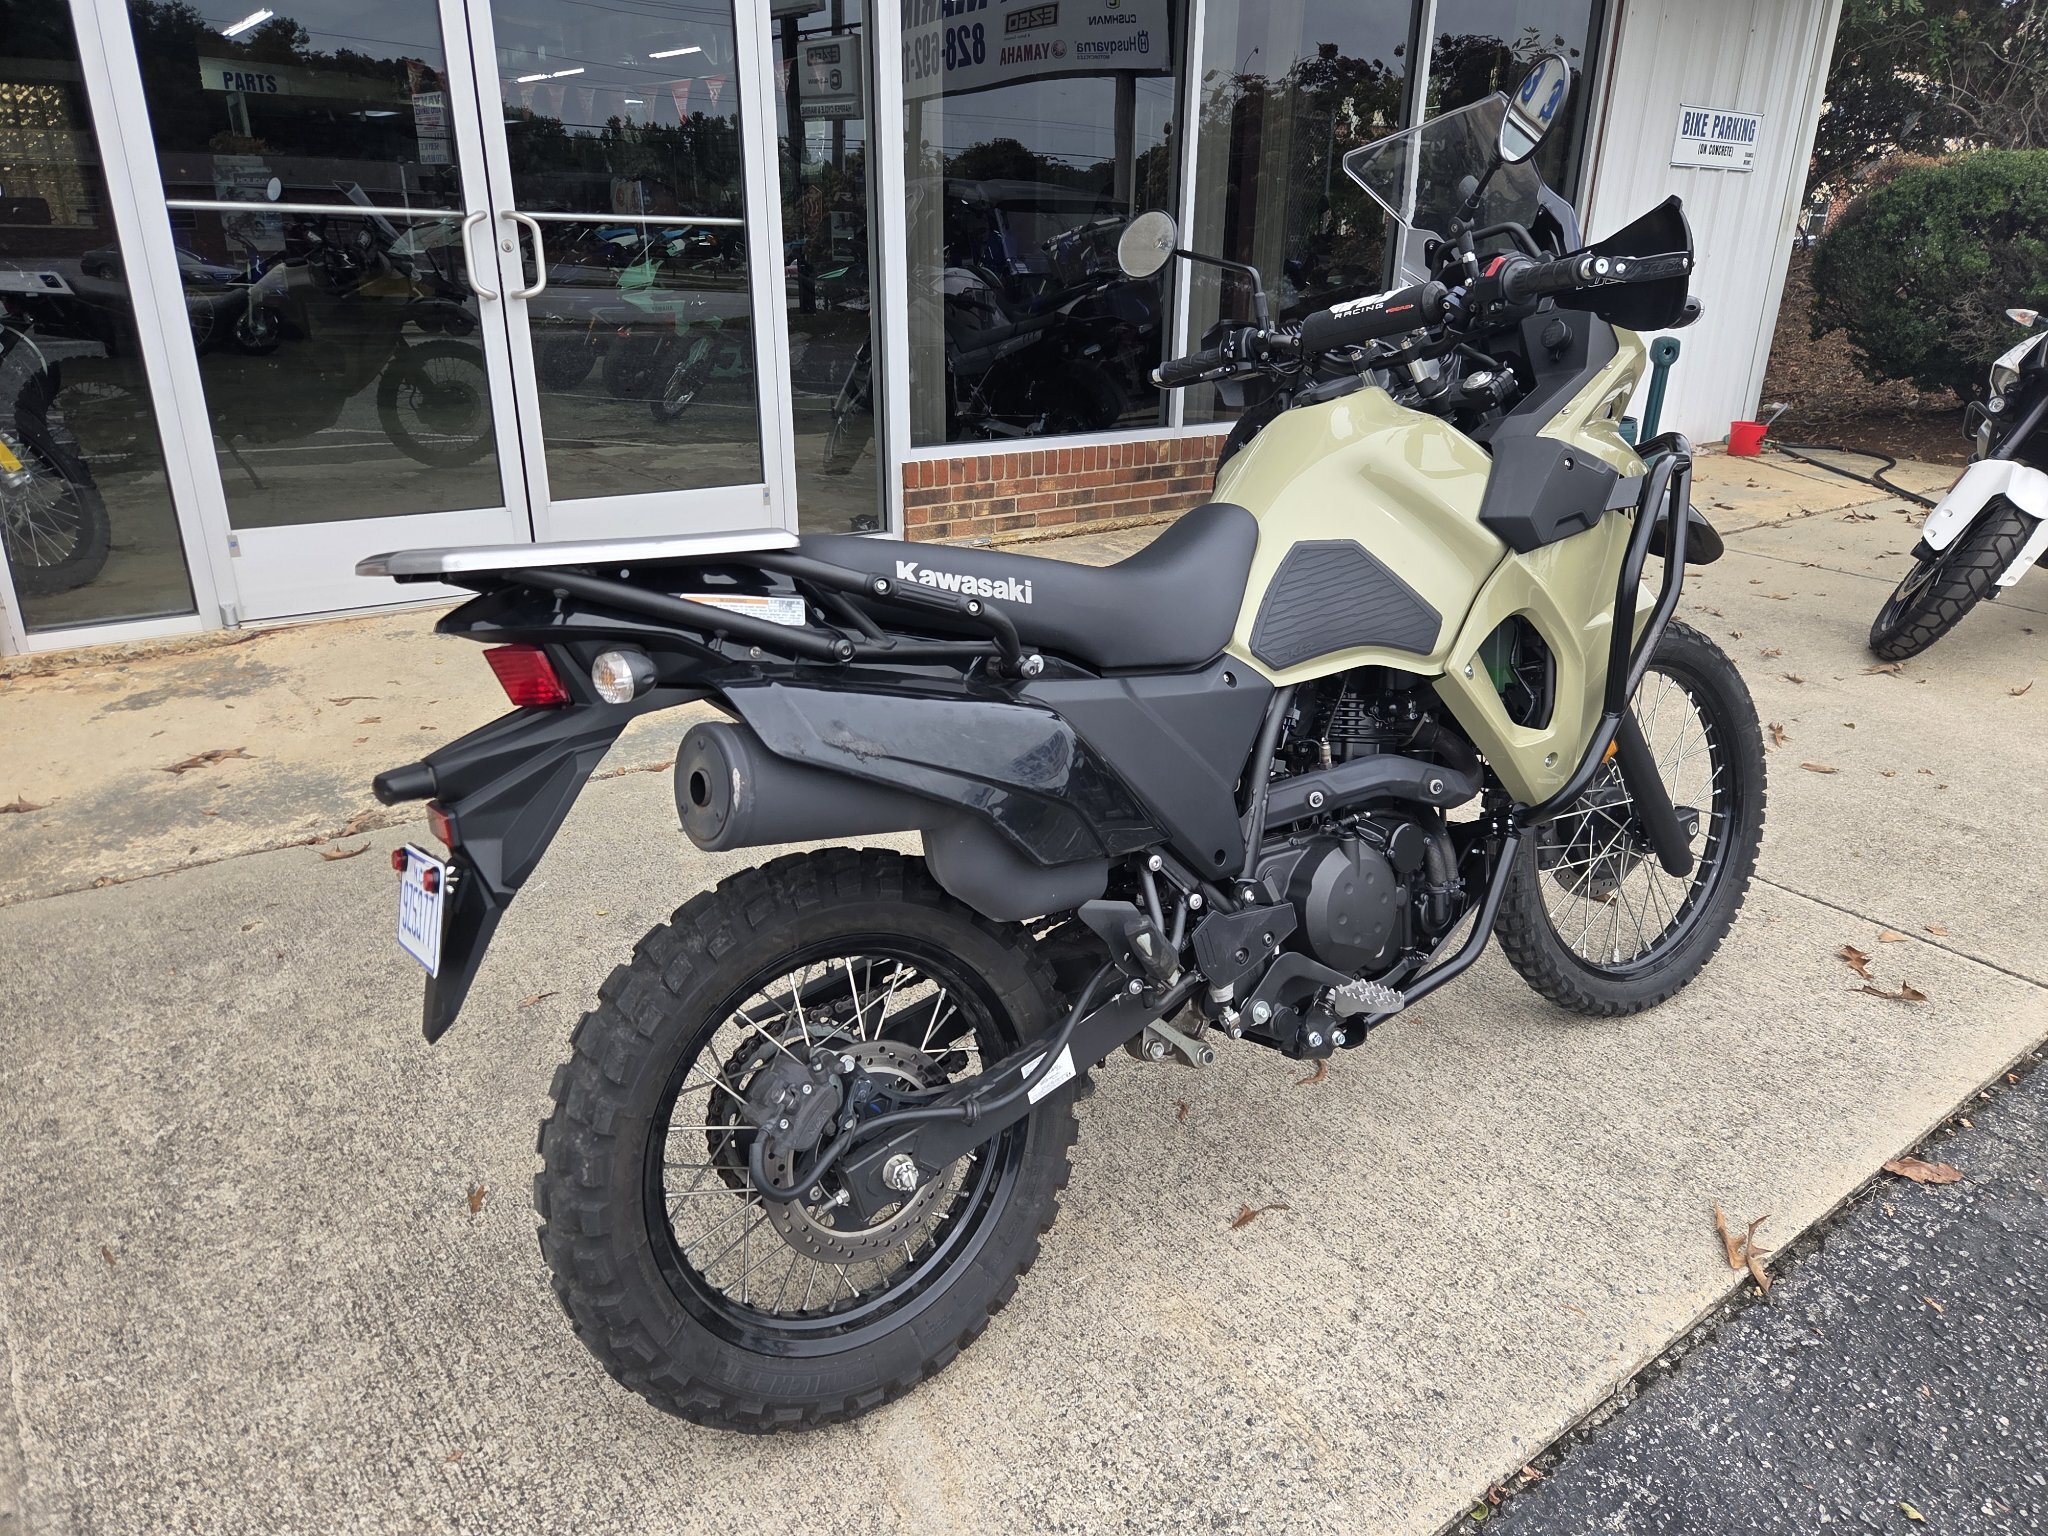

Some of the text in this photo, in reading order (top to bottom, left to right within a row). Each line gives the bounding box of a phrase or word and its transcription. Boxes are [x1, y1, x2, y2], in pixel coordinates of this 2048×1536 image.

[222, 71, 278, 93] PARTS
[1682, 111, 1757, 142] BIKE PARKING
[1697, 143, 1734, 158] (ON CONCRETE)
[1333, 302, 1384, 320] RACING
[895, 560, 1033, 604] Kawasaki
